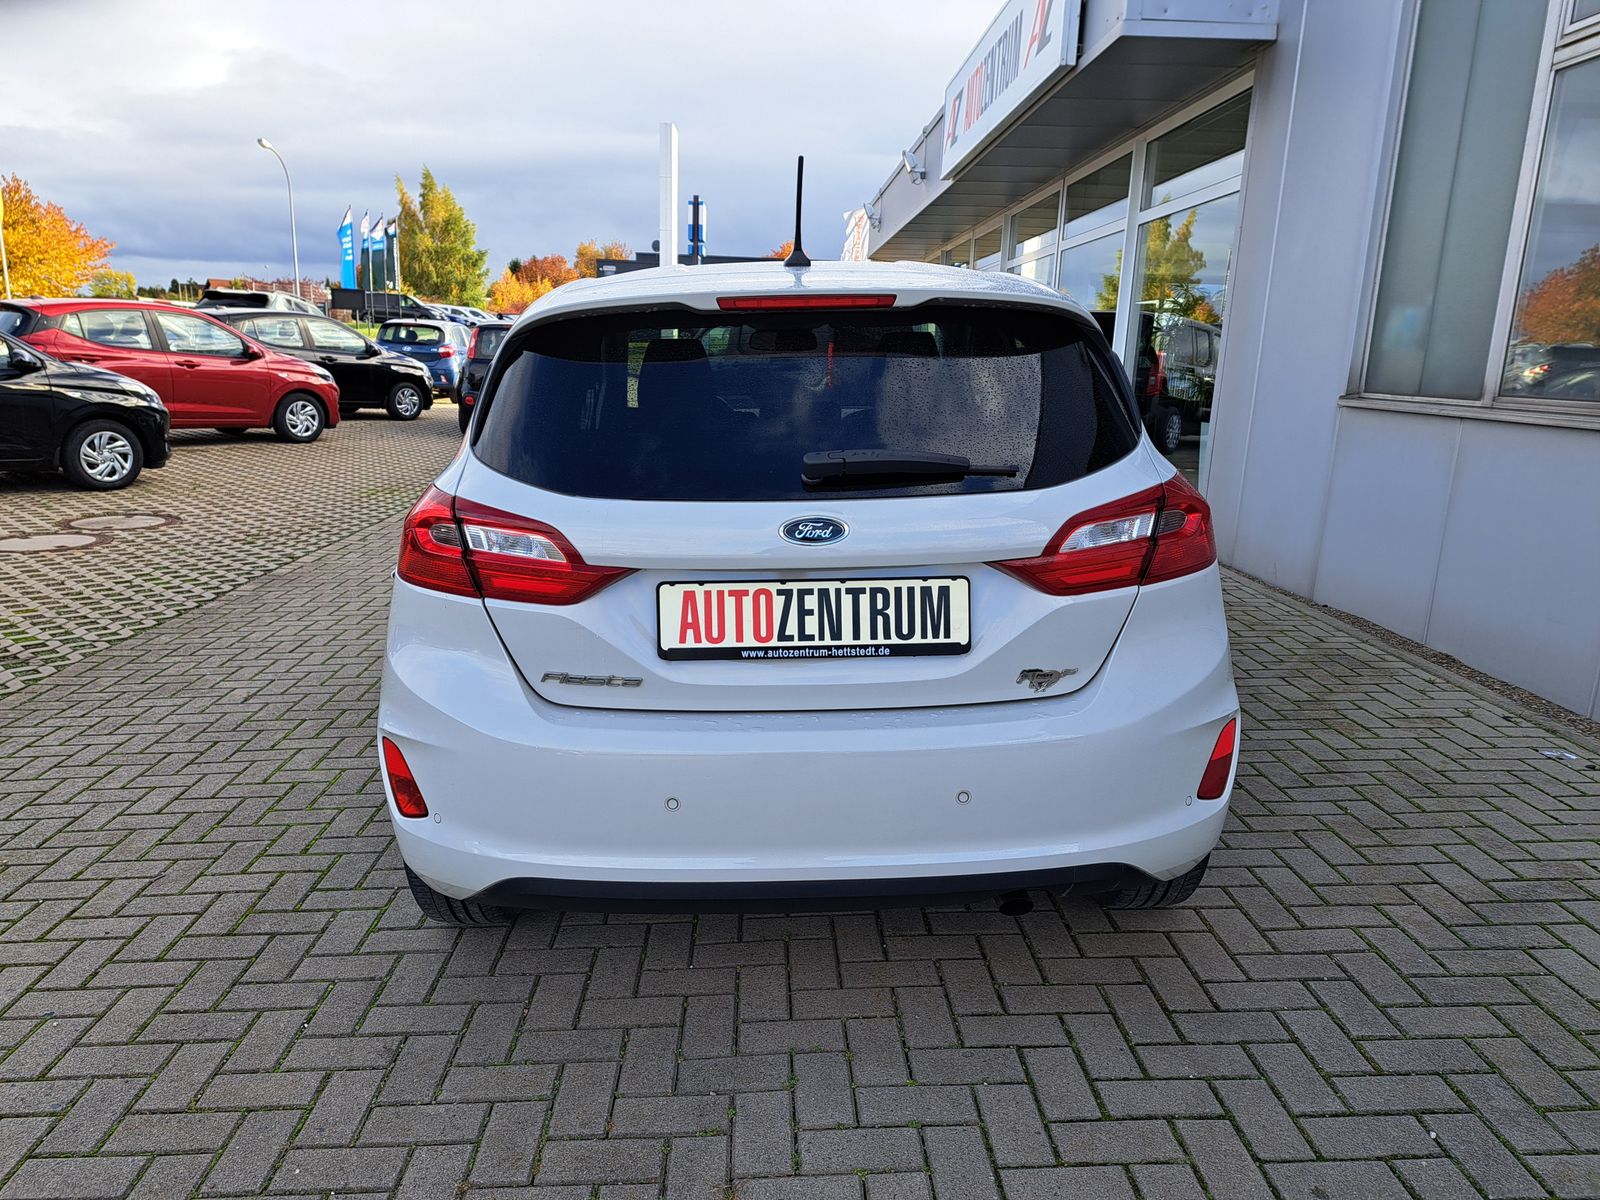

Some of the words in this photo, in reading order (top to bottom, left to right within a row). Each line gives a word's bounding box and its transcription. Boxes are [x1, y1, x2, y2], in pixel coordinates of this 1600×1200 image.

[964, 9, 1024, 135] AUTOZENTRUM
[795, 522, 833, 538] Ford
[678, 585, 951, 645] AUTOZENTRUM
[741, 646, 891, 658] www.autozentrum-hettstedt.de
